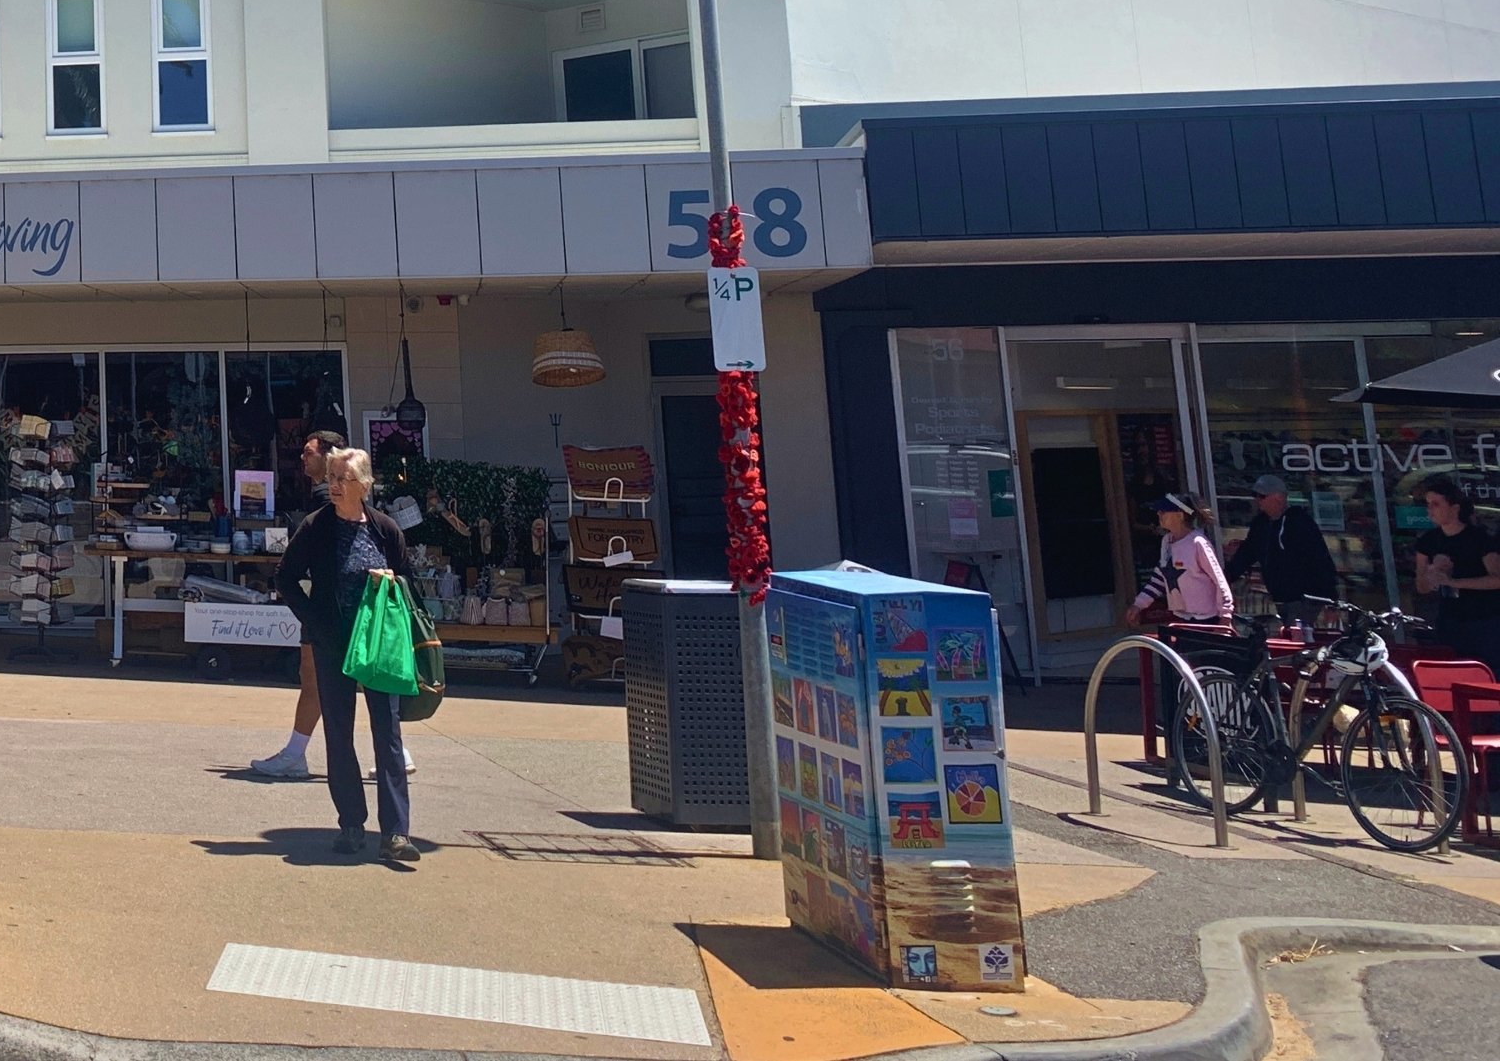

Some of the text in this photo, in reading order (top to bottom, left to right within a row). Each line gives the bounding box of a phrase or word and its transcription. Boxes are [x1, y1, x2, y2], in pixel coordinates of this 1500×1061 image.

[667, 187, 808, 260] 58
[931, 338, 965, 361] 56
[928, 406, 981, 420] Sports
[915, 422, 998, 435] Podiatrists
[1282, 433, 1500, 473] active f
[212, 619, 234, 637] Find
[243, 619, 264, 639] Love
